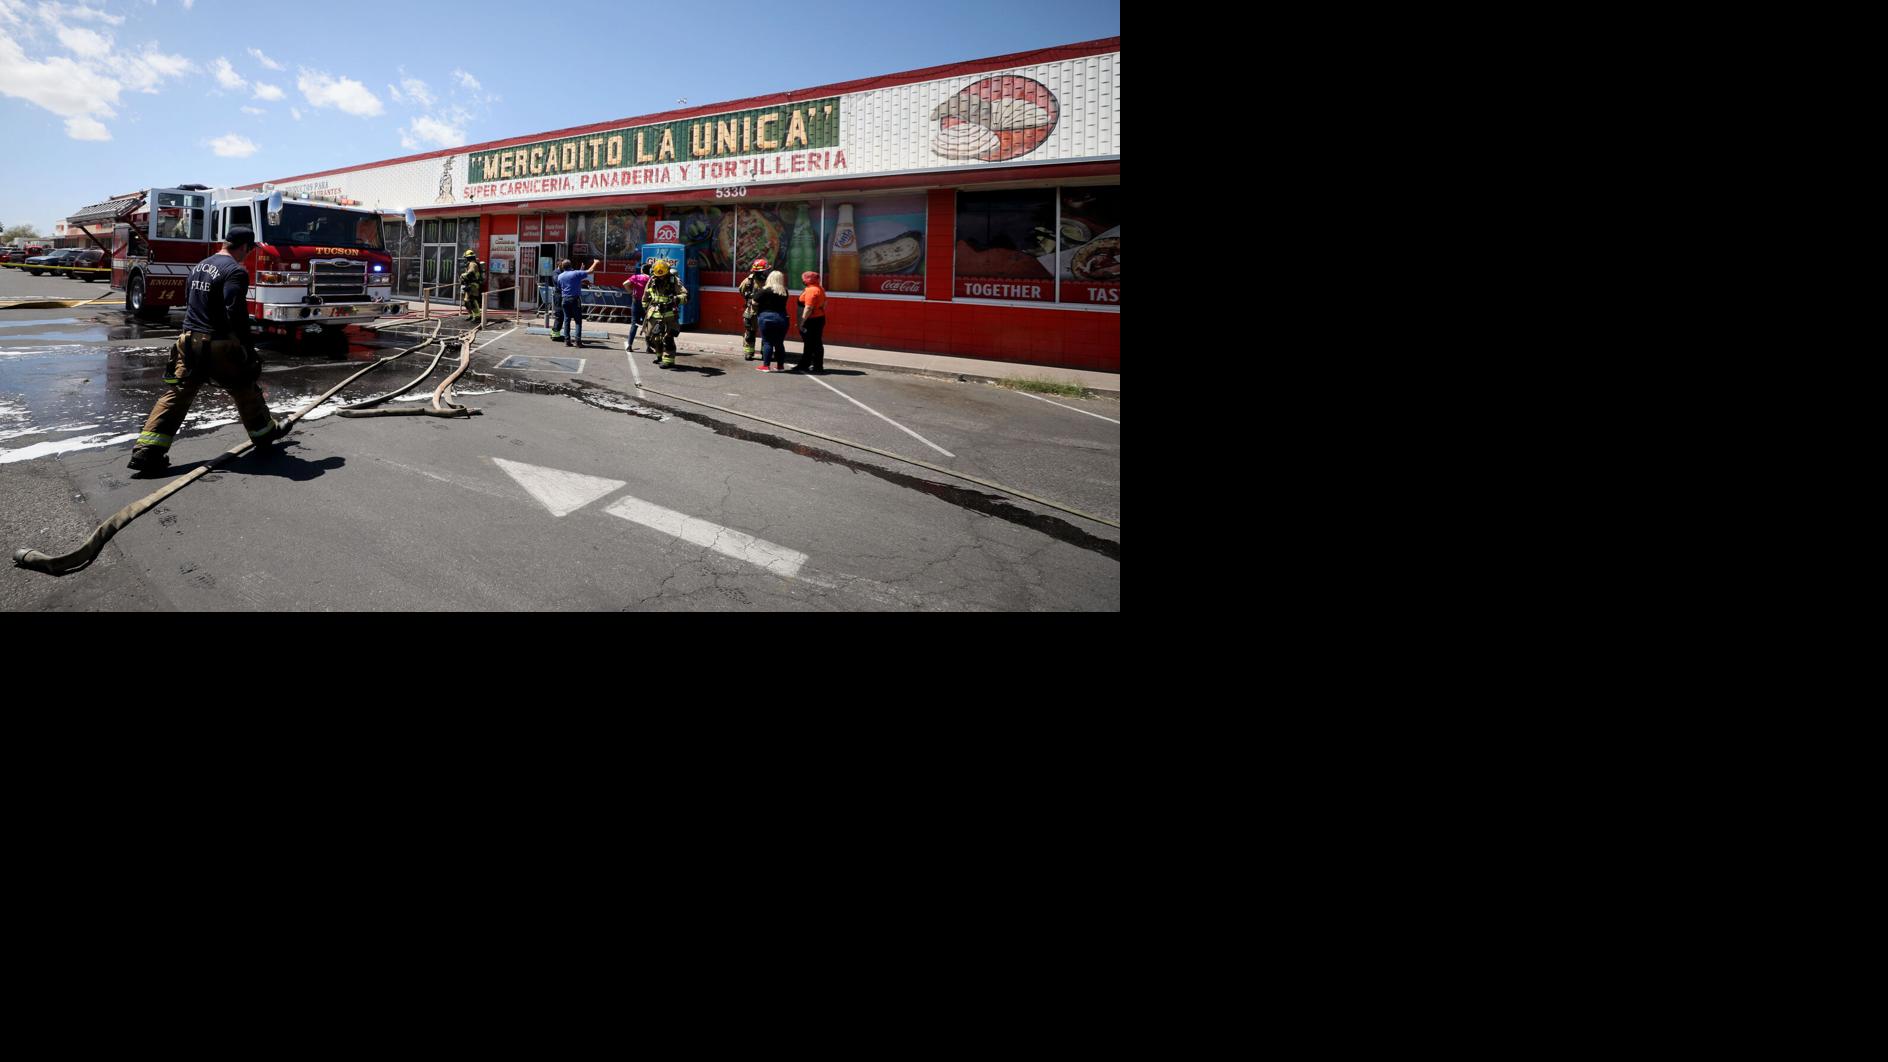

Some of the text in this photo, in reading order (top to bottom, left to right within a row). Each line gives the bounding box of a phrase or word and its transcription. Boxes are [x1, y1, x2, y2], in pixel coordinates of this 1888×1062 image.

[636, 128, 675, 163] LA
[463, 150, 848, 199] SUPER CARNICERIA, PANADERIA Y TORTILLERIA
[716, 187, 747, 198] 5330
[315, 247, 360, 256] TUCSON
[191, 280, 211, 292] FIRE
[964, 283, 1041, 298] TOGETHER
[158, 290, 175, 299] 14
